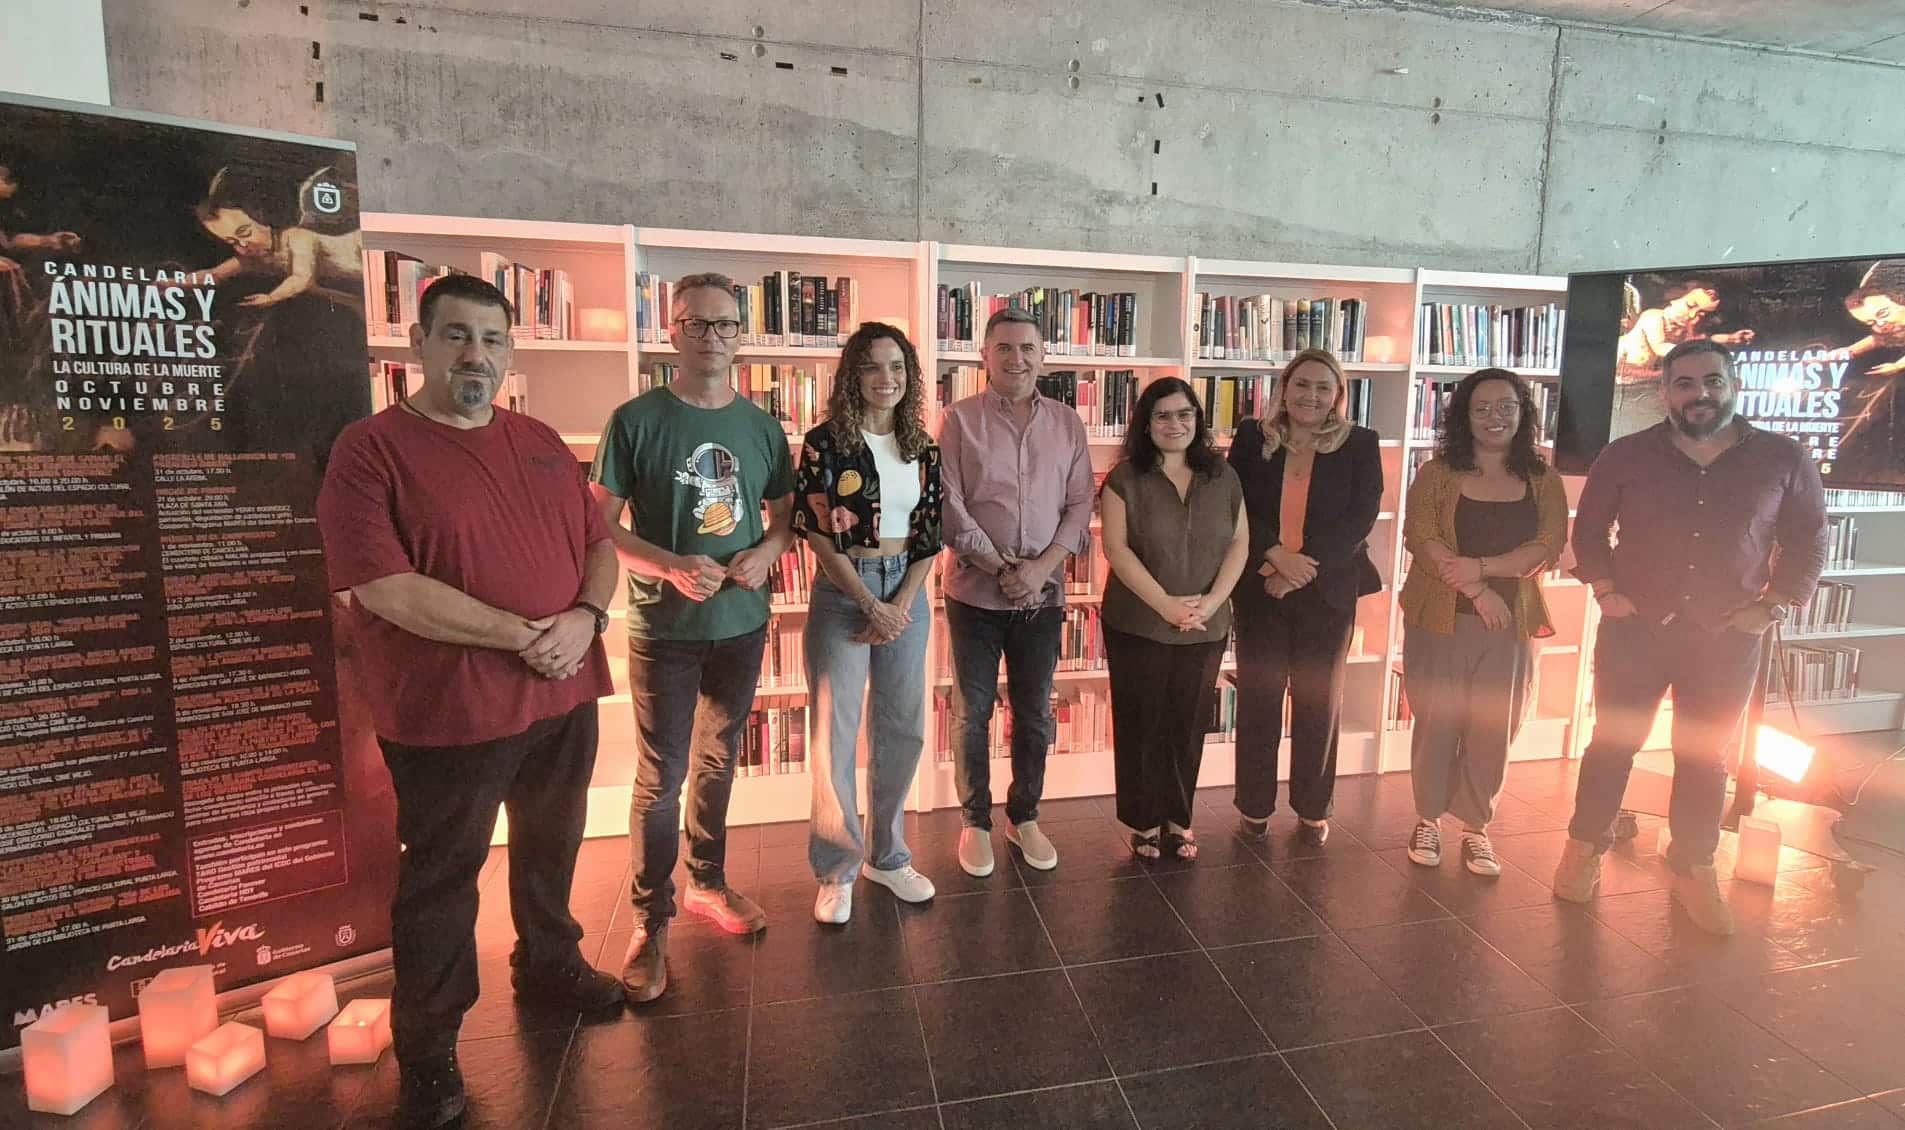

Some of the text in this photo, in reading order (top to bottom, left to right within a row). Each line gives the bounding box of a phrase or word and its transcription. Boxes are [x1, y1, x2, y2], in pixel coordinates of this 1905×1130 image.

[45, 261, 216, 286] CANDELARIA
[49, 275, 216, 322] ÁNIMAS Y
[51, 319, 216, 358] RITUALES
[53, 361, 222, 378] LA CULTURA DE LA MUERTE
[1733, 362, 1849, 390] NIMAS Y
[55, 381, 224, 396] OCTUBRE
[57, 397, 225, 412] NOVIEMBRE
[1735, 390, 1841, 418] ITUALES
[62, 416, 223, 432] 2025
[107, 939, 200, 971] Candelaria
[196, 920, 266, 957] Viva
